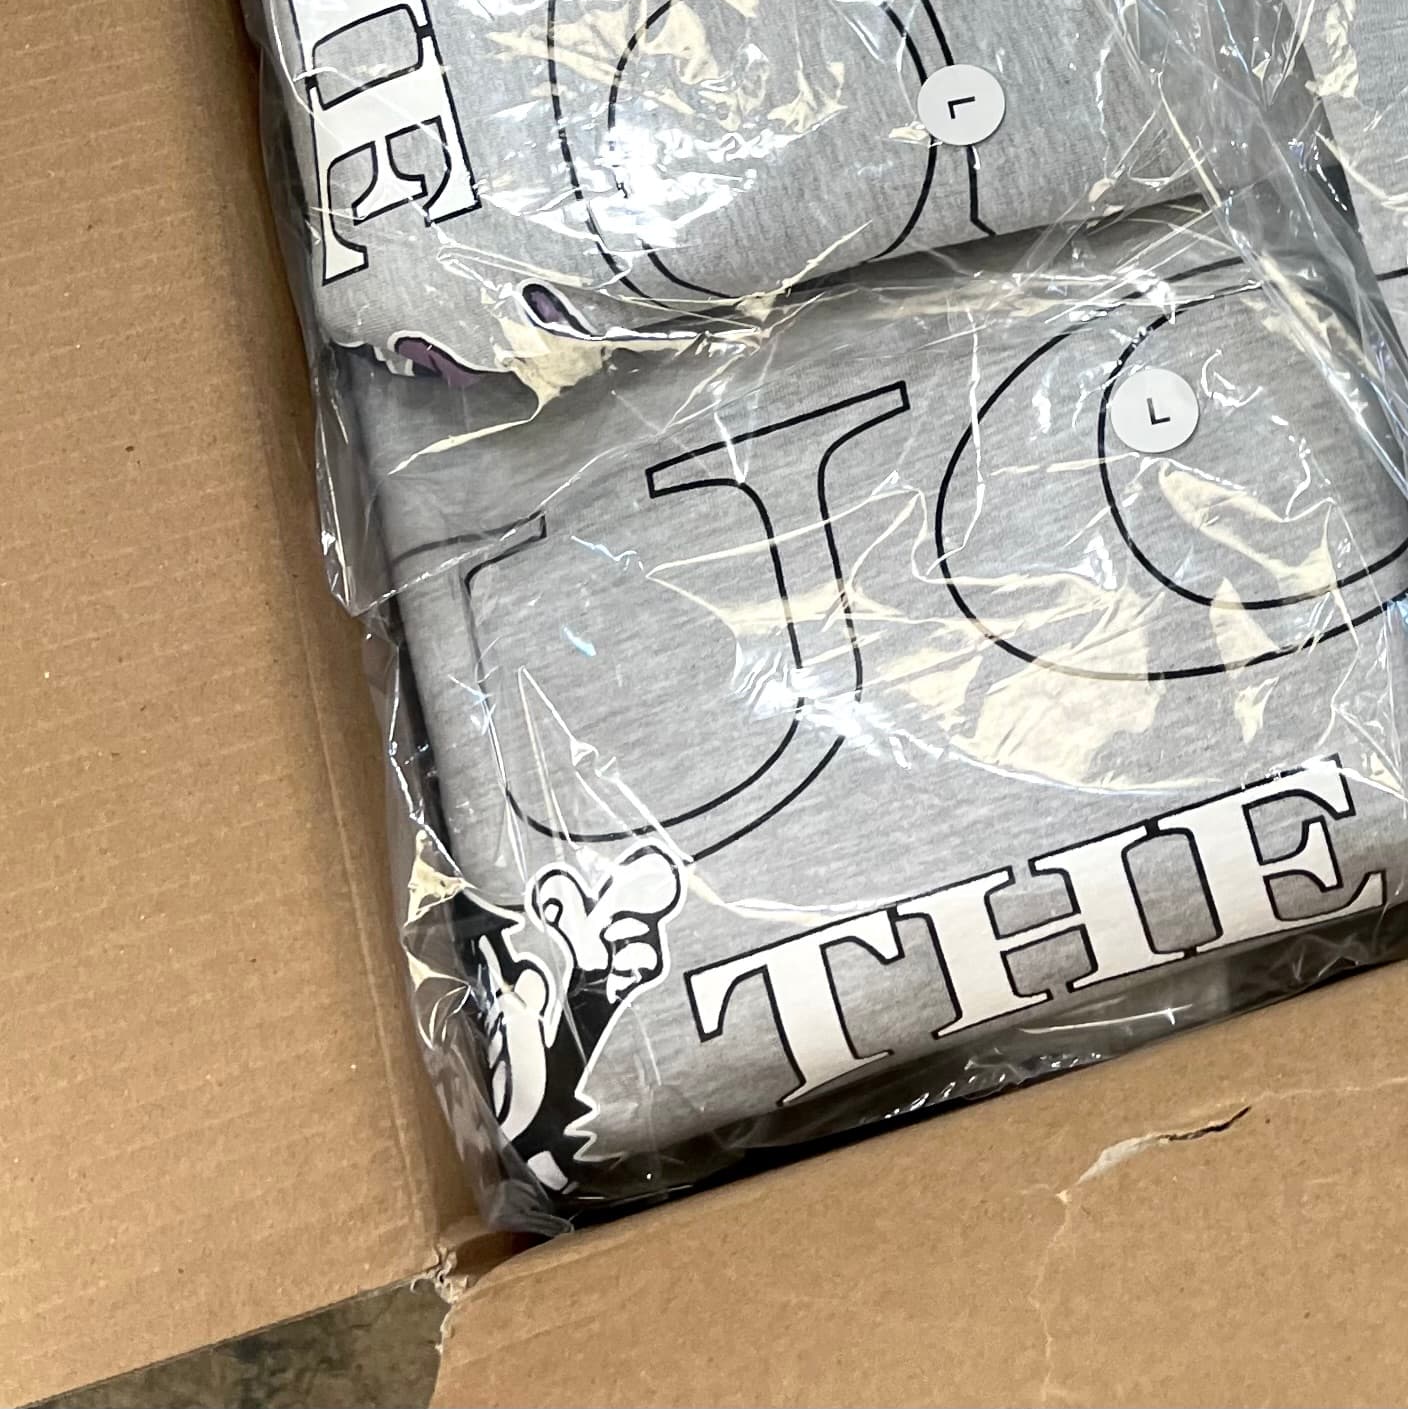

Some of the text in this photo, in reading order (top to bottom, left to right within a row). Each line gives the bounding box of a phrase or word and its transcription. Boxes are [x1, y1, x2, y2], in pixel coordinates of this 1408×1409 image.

[947, 95, 976, 120] L
[1146, 396, 1171, 425] L
[683, 752, 1388, 1109] THE
